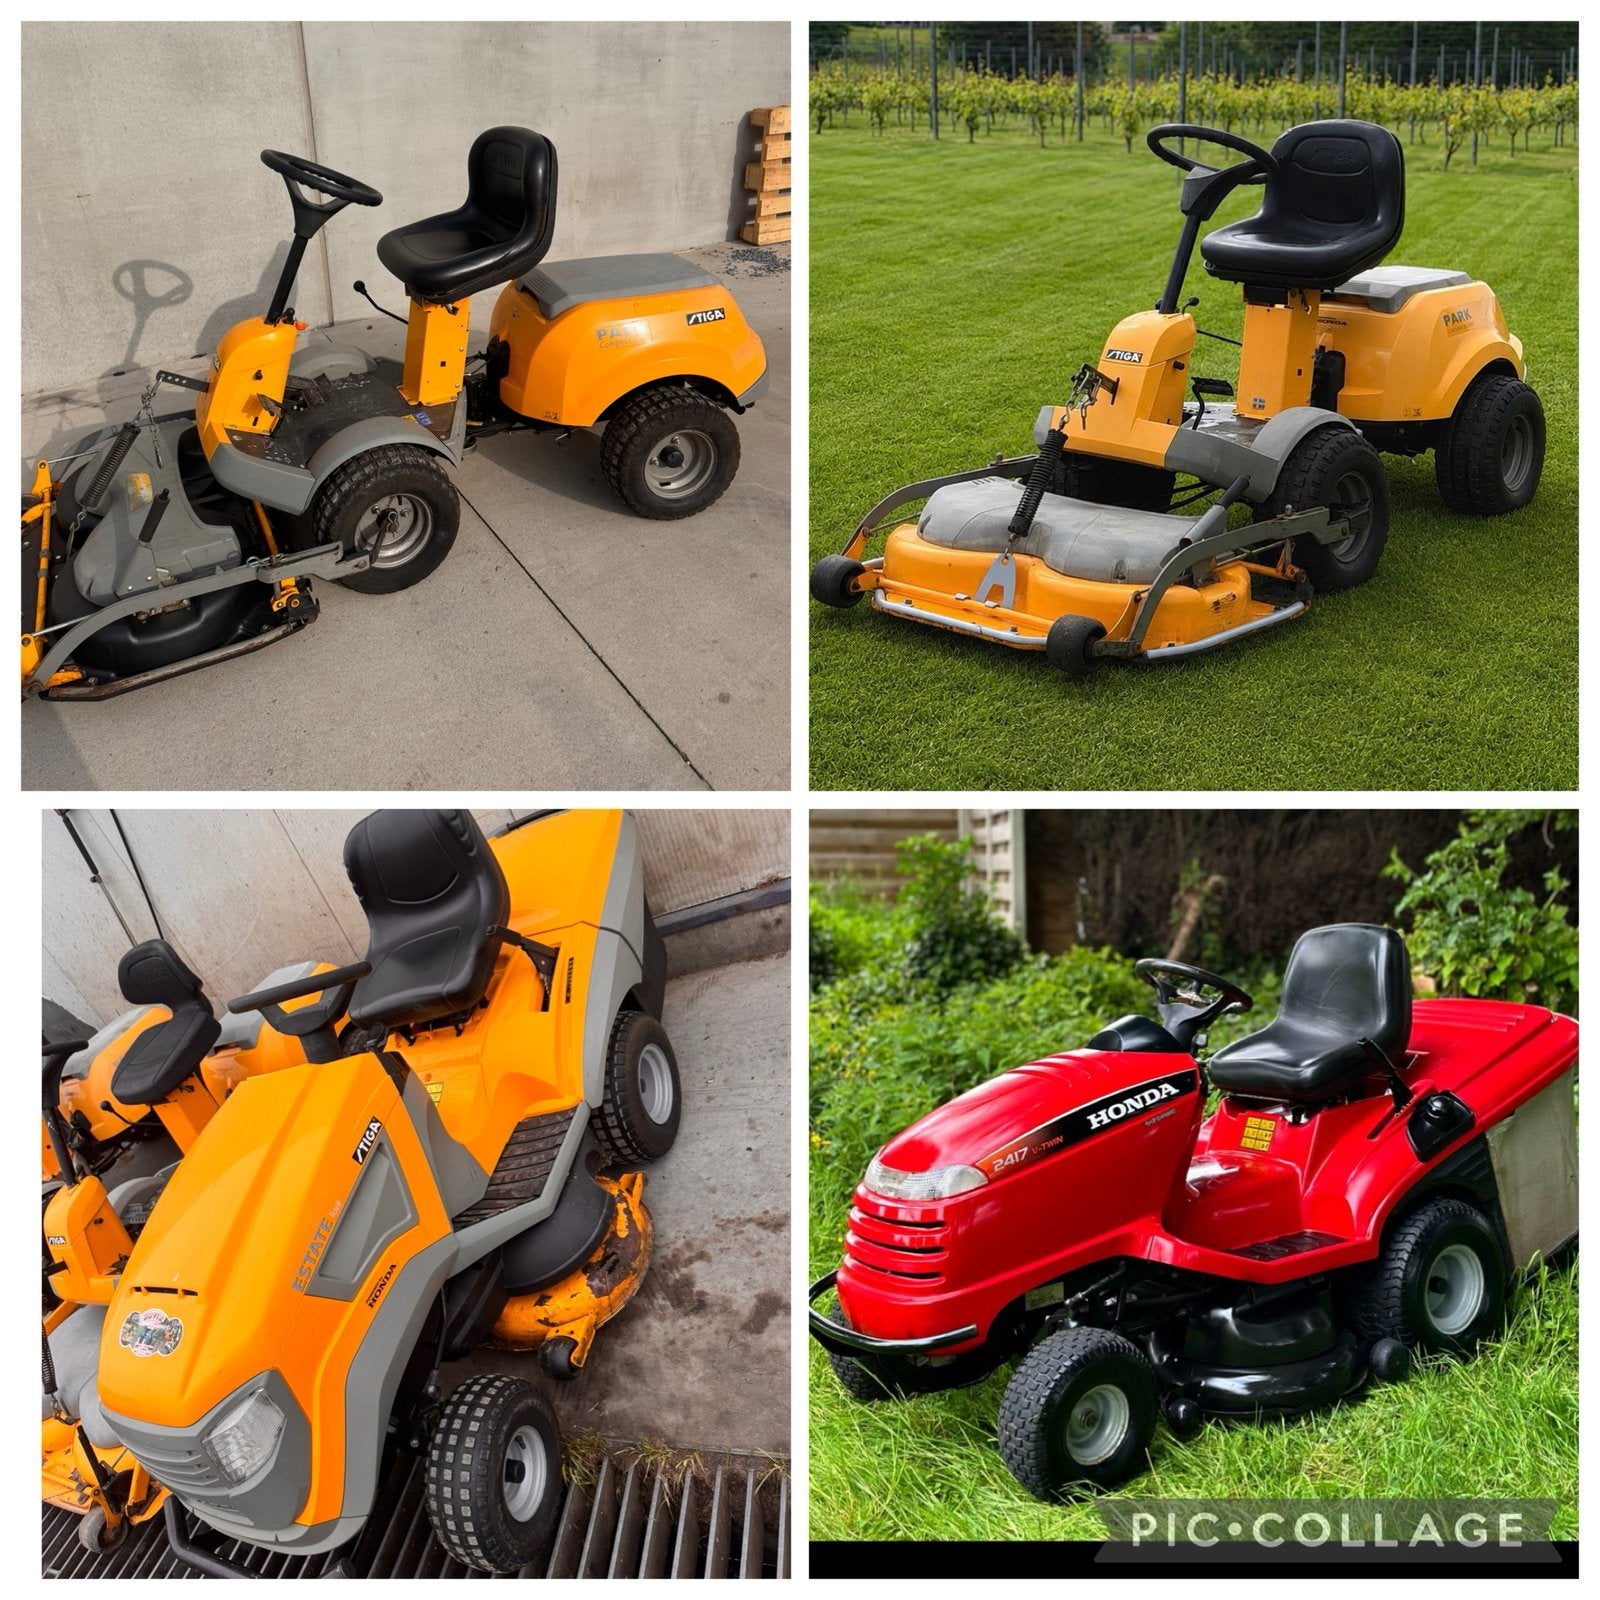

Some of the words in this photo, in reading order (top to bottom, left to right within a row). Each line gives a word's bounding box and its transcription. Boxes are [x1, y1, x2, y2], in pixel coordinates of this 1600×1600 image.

[596, 324, 640, 341] PA
[687, 309, 724, 325] STIGA
[1442, 308, 1472, 327] PARK
[1106, 350, 1141, 362] STIGA
[1086, 1082, 1179, 1130] HONDA
[355, 1119, 382, 1165] STIGA
[992, 1147, 1029, 1173] 2417
[1031, 1135, 1064, 1155] V-TWIN
[291, 1217, 333, 1292] ESTATE
[368, 1263, 397, 1309] HONDA
